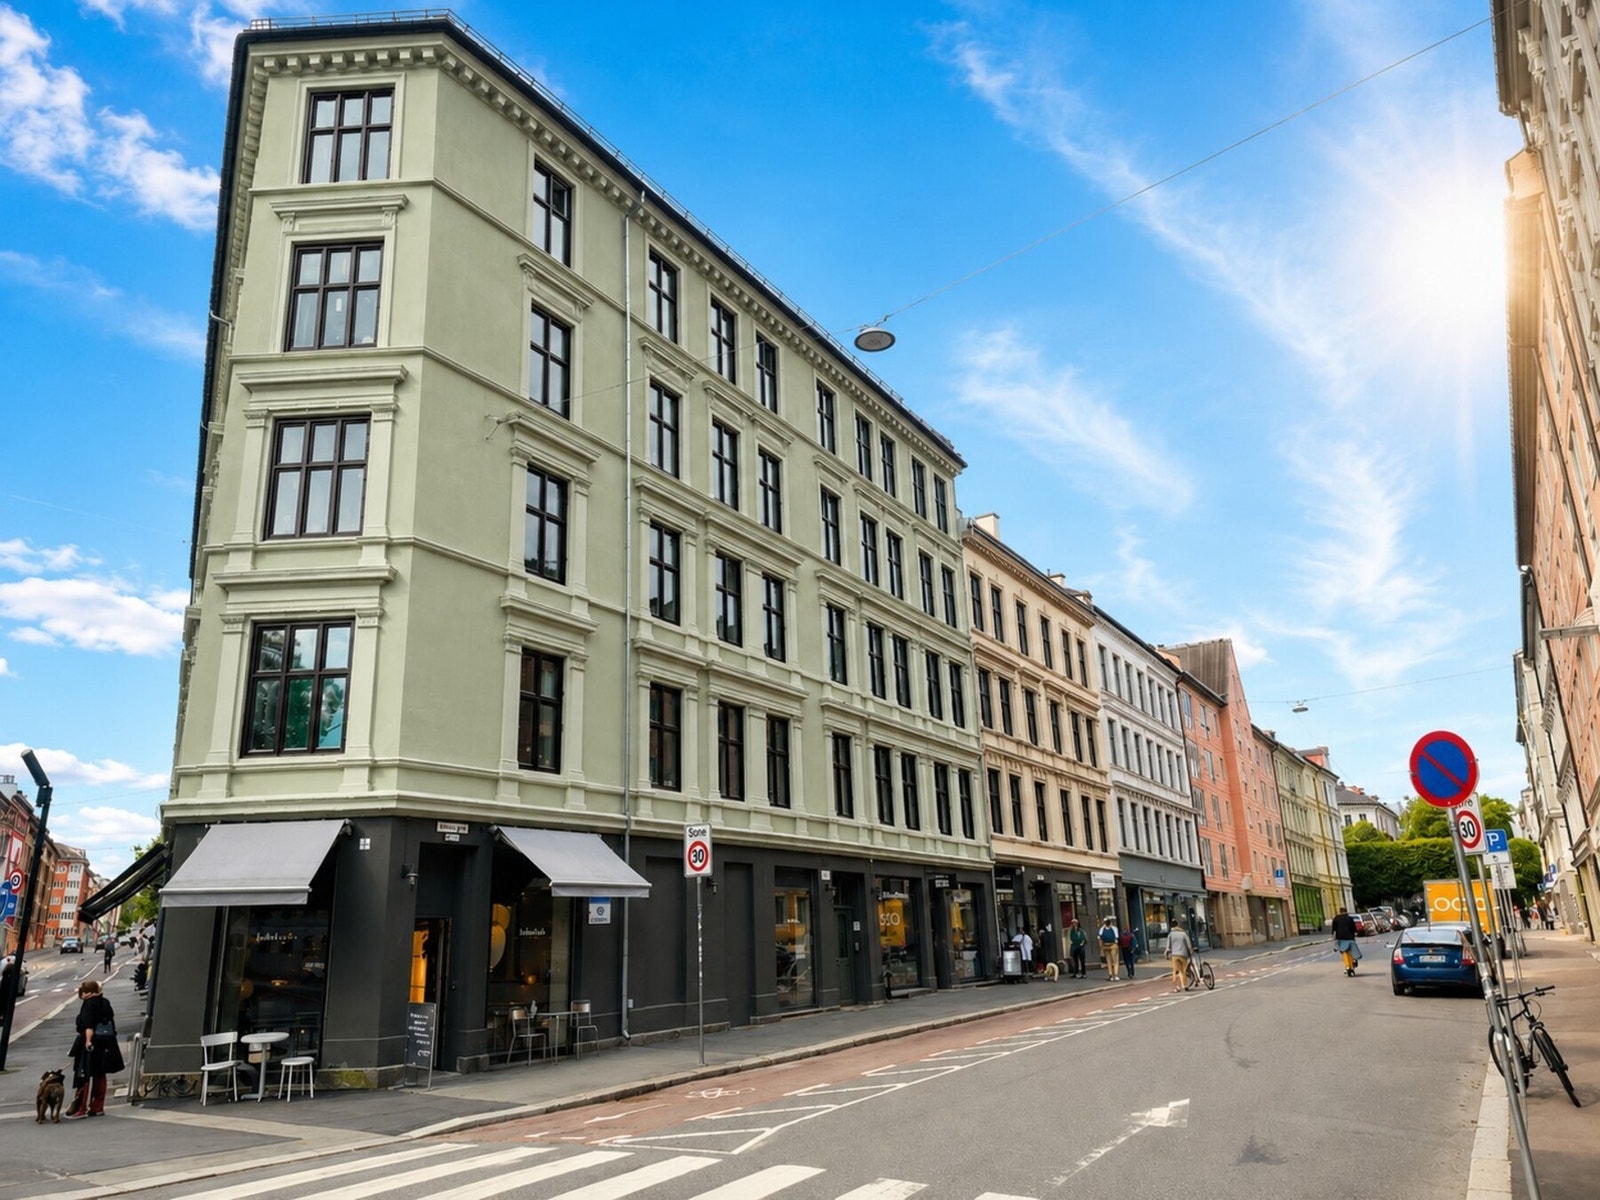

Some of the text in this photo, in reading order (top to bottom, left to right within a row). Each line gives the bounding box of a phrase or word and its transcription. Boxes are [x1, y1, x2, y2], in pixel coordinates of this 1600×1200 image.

[688, 828, 707, 838] Sone
[1460, 820, 1475, 838] 30
[1486, 833, 1499, 846] P
[692, 849, 704, 863] 30
